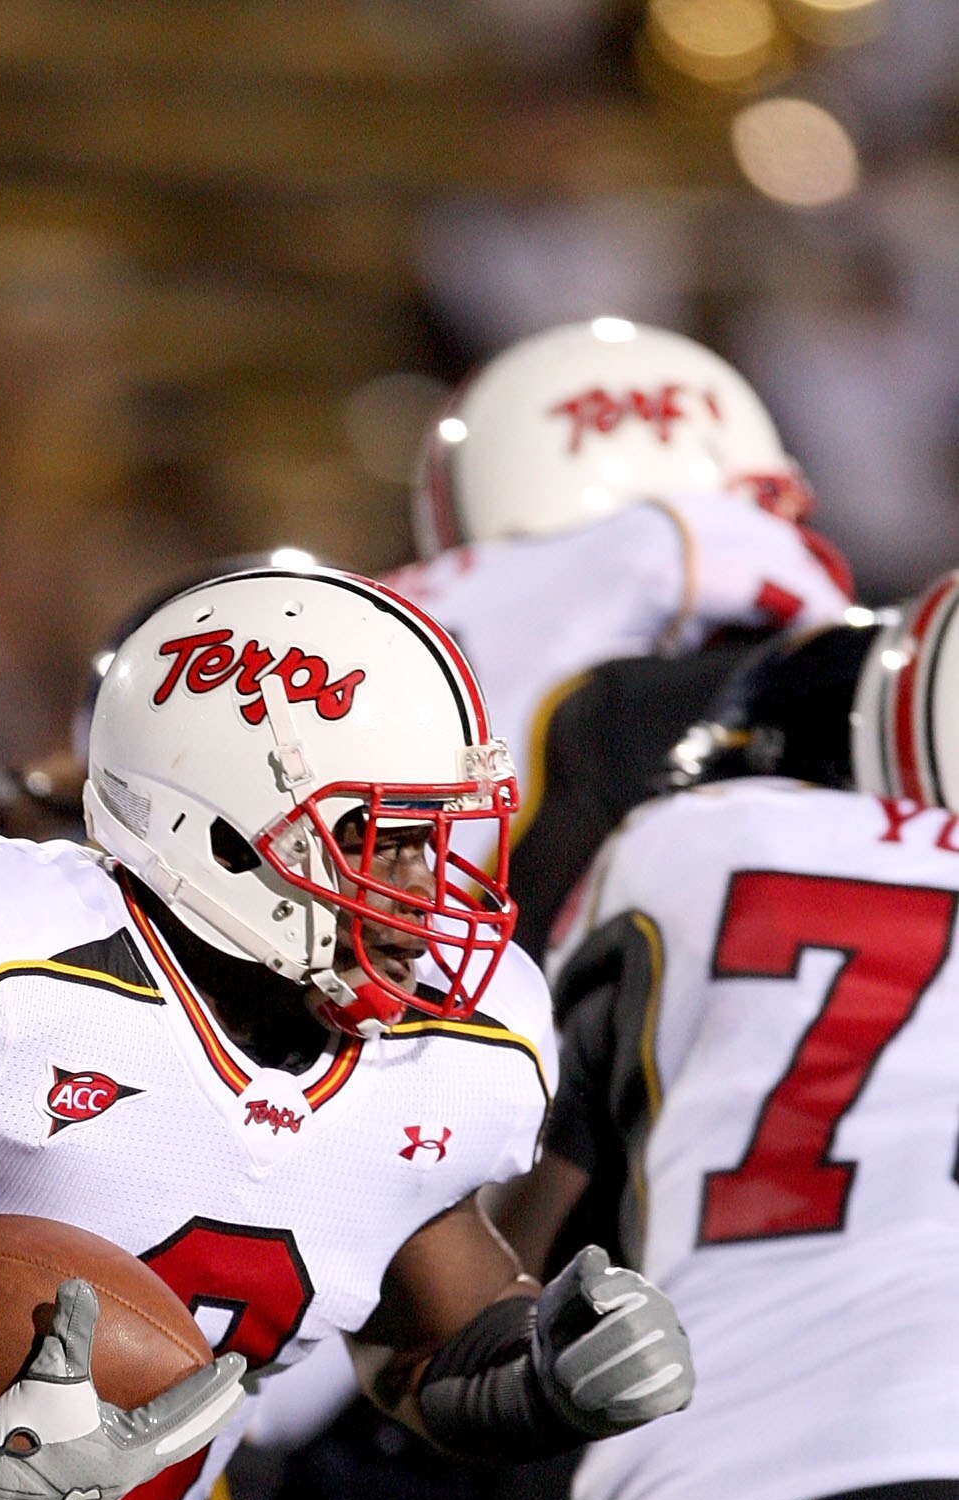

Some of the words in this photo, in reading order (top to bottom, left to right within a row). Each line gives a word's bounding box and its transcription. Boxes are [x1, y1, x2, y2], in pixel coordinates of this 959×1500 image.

[153, 629, 366, 725] Terps
[696, 868, 959, 1247] 7
[51, 1084, 108, 1112] ACC
[244, 1099, 305, 1136] Terps
